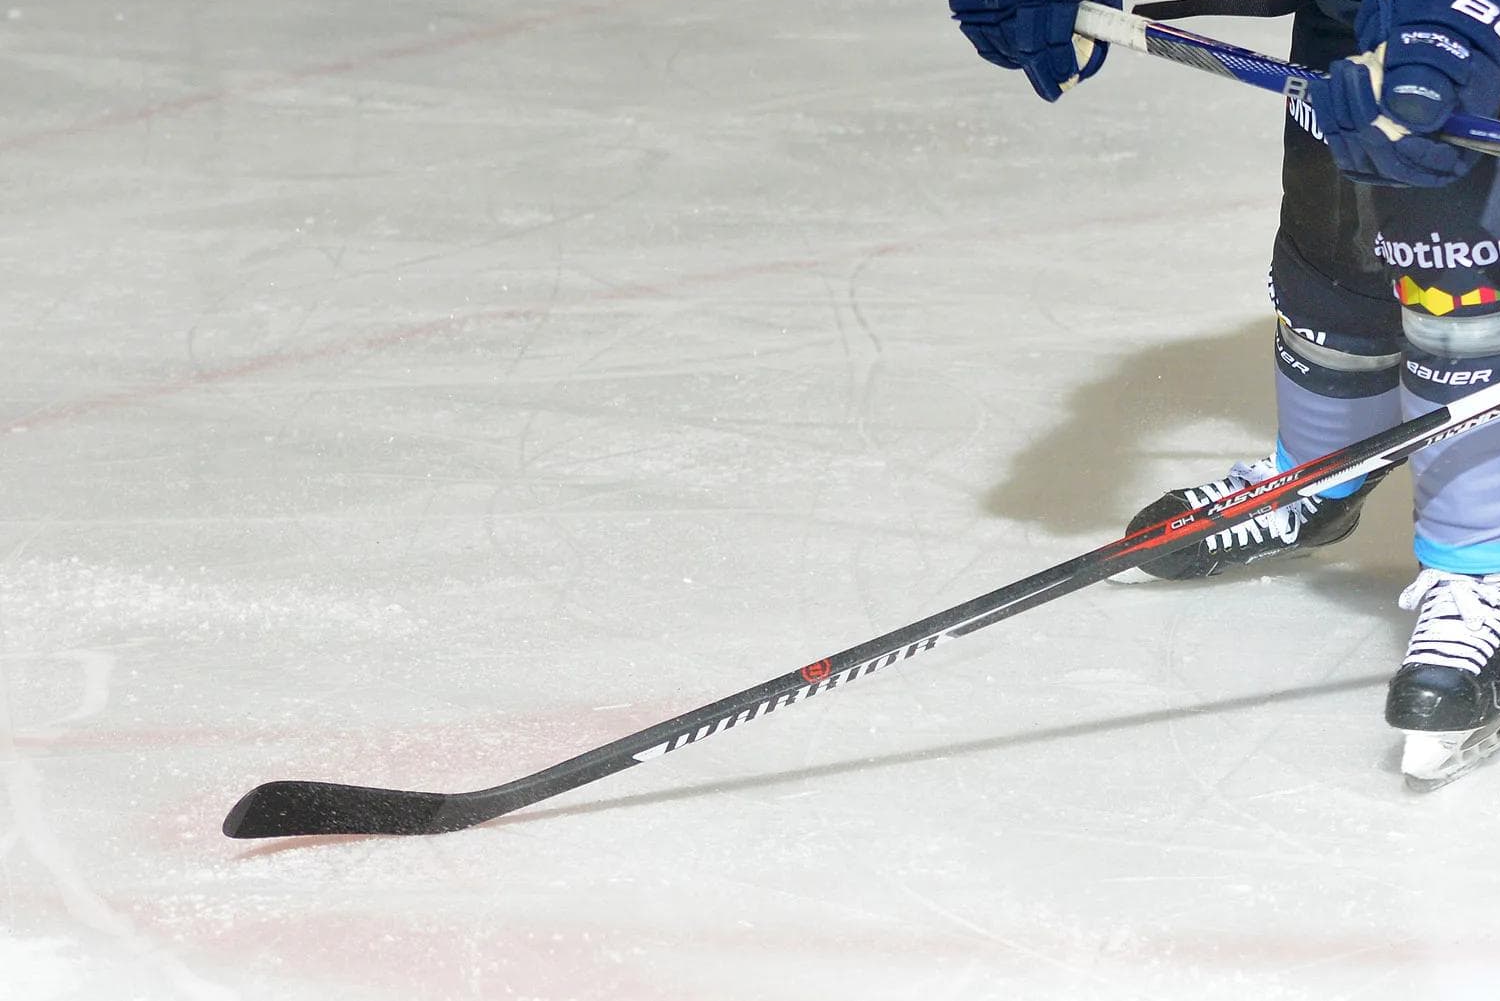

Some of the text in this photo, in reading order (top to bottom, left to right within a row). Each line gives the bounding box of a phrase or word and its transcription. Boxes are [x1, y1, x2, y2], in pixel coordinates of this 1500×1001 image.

[1401, 32, 1470, 58] NEXUS
[1288, 96, 1329, 145] SATU
[1406, 359, 1494, 386] BAUER
[1170, 512, 1195, 531] HD
[660, 633, 942, 756] WARRIOR
